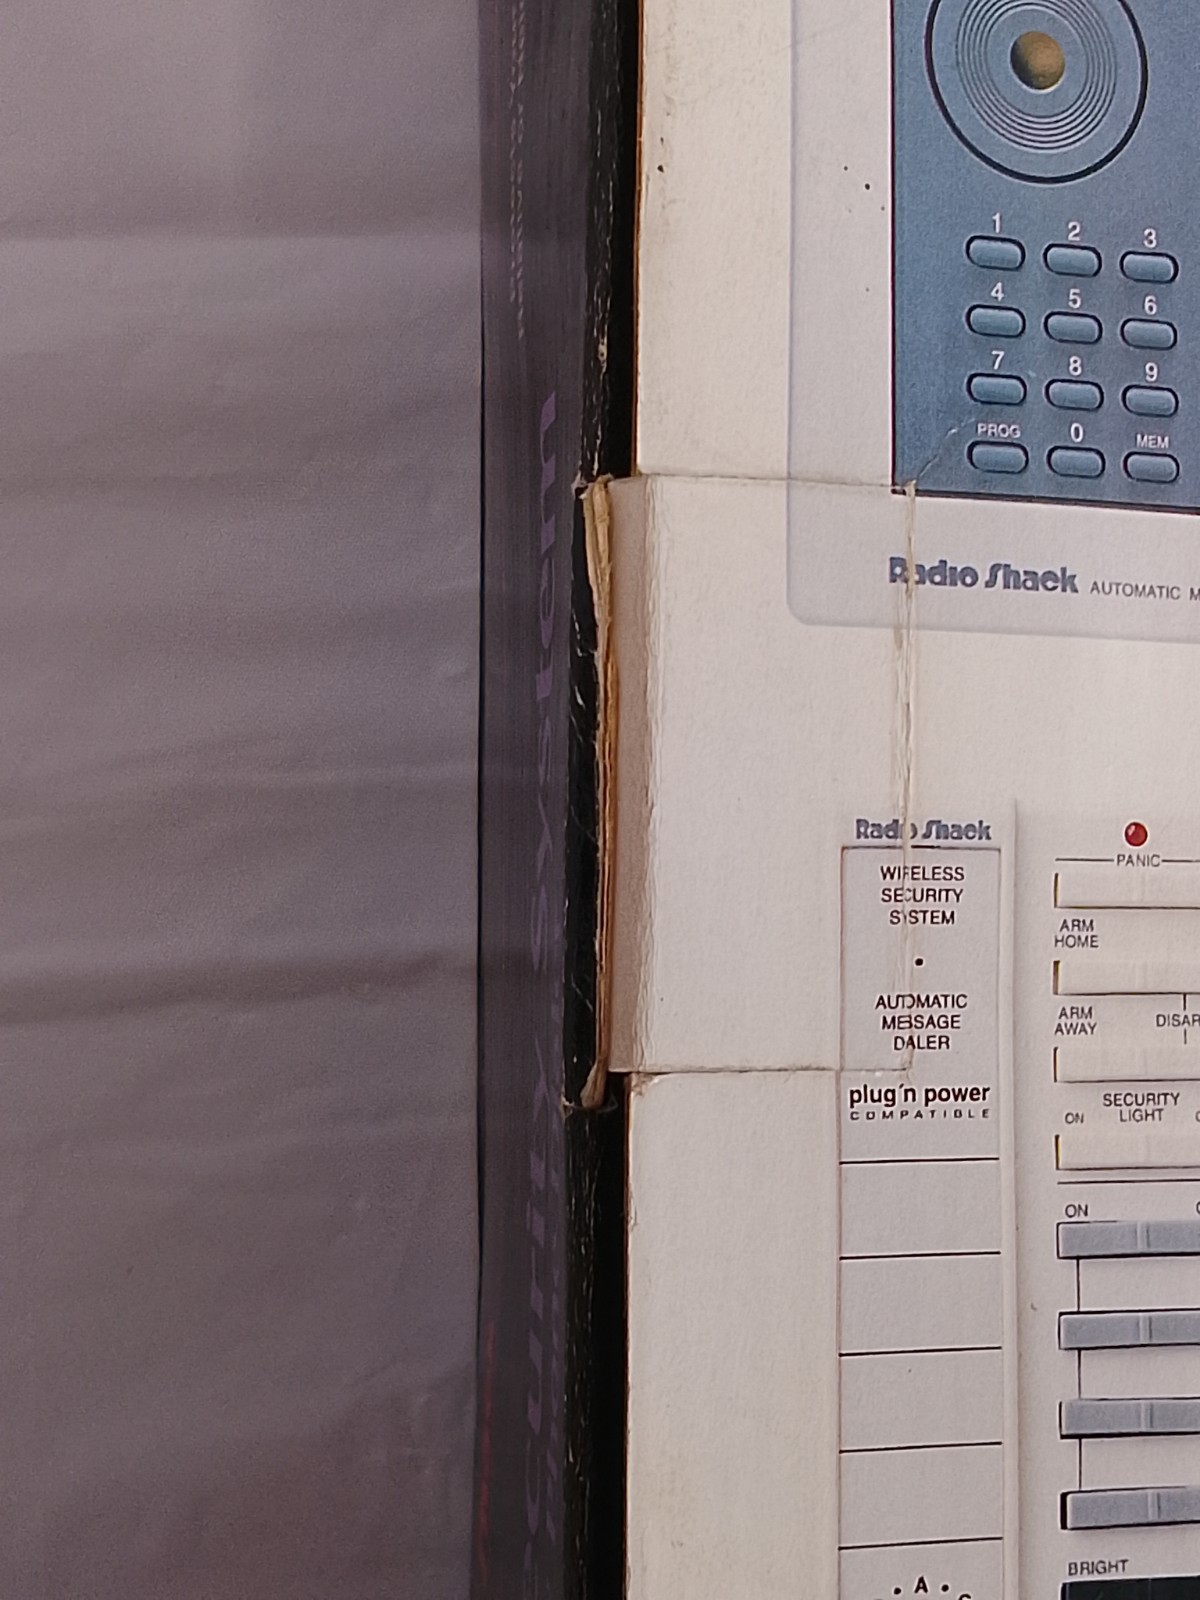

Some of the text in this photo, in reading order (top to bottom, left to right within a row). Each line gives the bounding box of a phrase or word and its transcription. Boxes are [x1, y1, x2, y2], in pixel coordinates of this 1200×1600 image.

[992, 212, 1001, 234] 1
[1067, 221, 1080, 241] 2
[1143, 229, 1156, 248] 3
[991, 282, 1004, 301] 4
[1069, 289, 1081, 308] 5
[1144, 296, 1157, 315] 6
[992, 350, 1004, 370] 7
[1069, 356, 1082, 376] 8
[1145, 362, 1158, 381] 9
[977, 423, 1021, 439] PROG
[1070, 423, 1083, 442] 0
[1136, 434, 1169, 449] MEM
[889, 556, 979, 588] Radio
[984, 563, 1079, 593] Shack
[1090, 581, 1181, 600] AUTOMATIC
[531, 390, 556, 974] System
[921, 820, 992, 840] Shack
[1116, 853, 1161, 867] PANIC
[881, 888, 964, 903] SECURITY
[1059, 919, 1094, 932] ARM
[1054, 934, 1099, 948] HOME
[1058, 1006, 1093, 1019] ARM
[1054, 1022, 1097, 1036] AWAY
[924, 1086, 991, 1107] power
[1103, 1092, 1180, 1107] SECURITY
[850, 1109, 990, 1121] COMPATIBLE
[1064, 1112, 1085, 1124] ON
[1119, 1108, 1164, 1122] LIGHT
[1064, 1204, 1089, 1218] ON
[1067, 1558, 1129, 1576] BRIGHT
[913, 1576, 929, 1594] A
